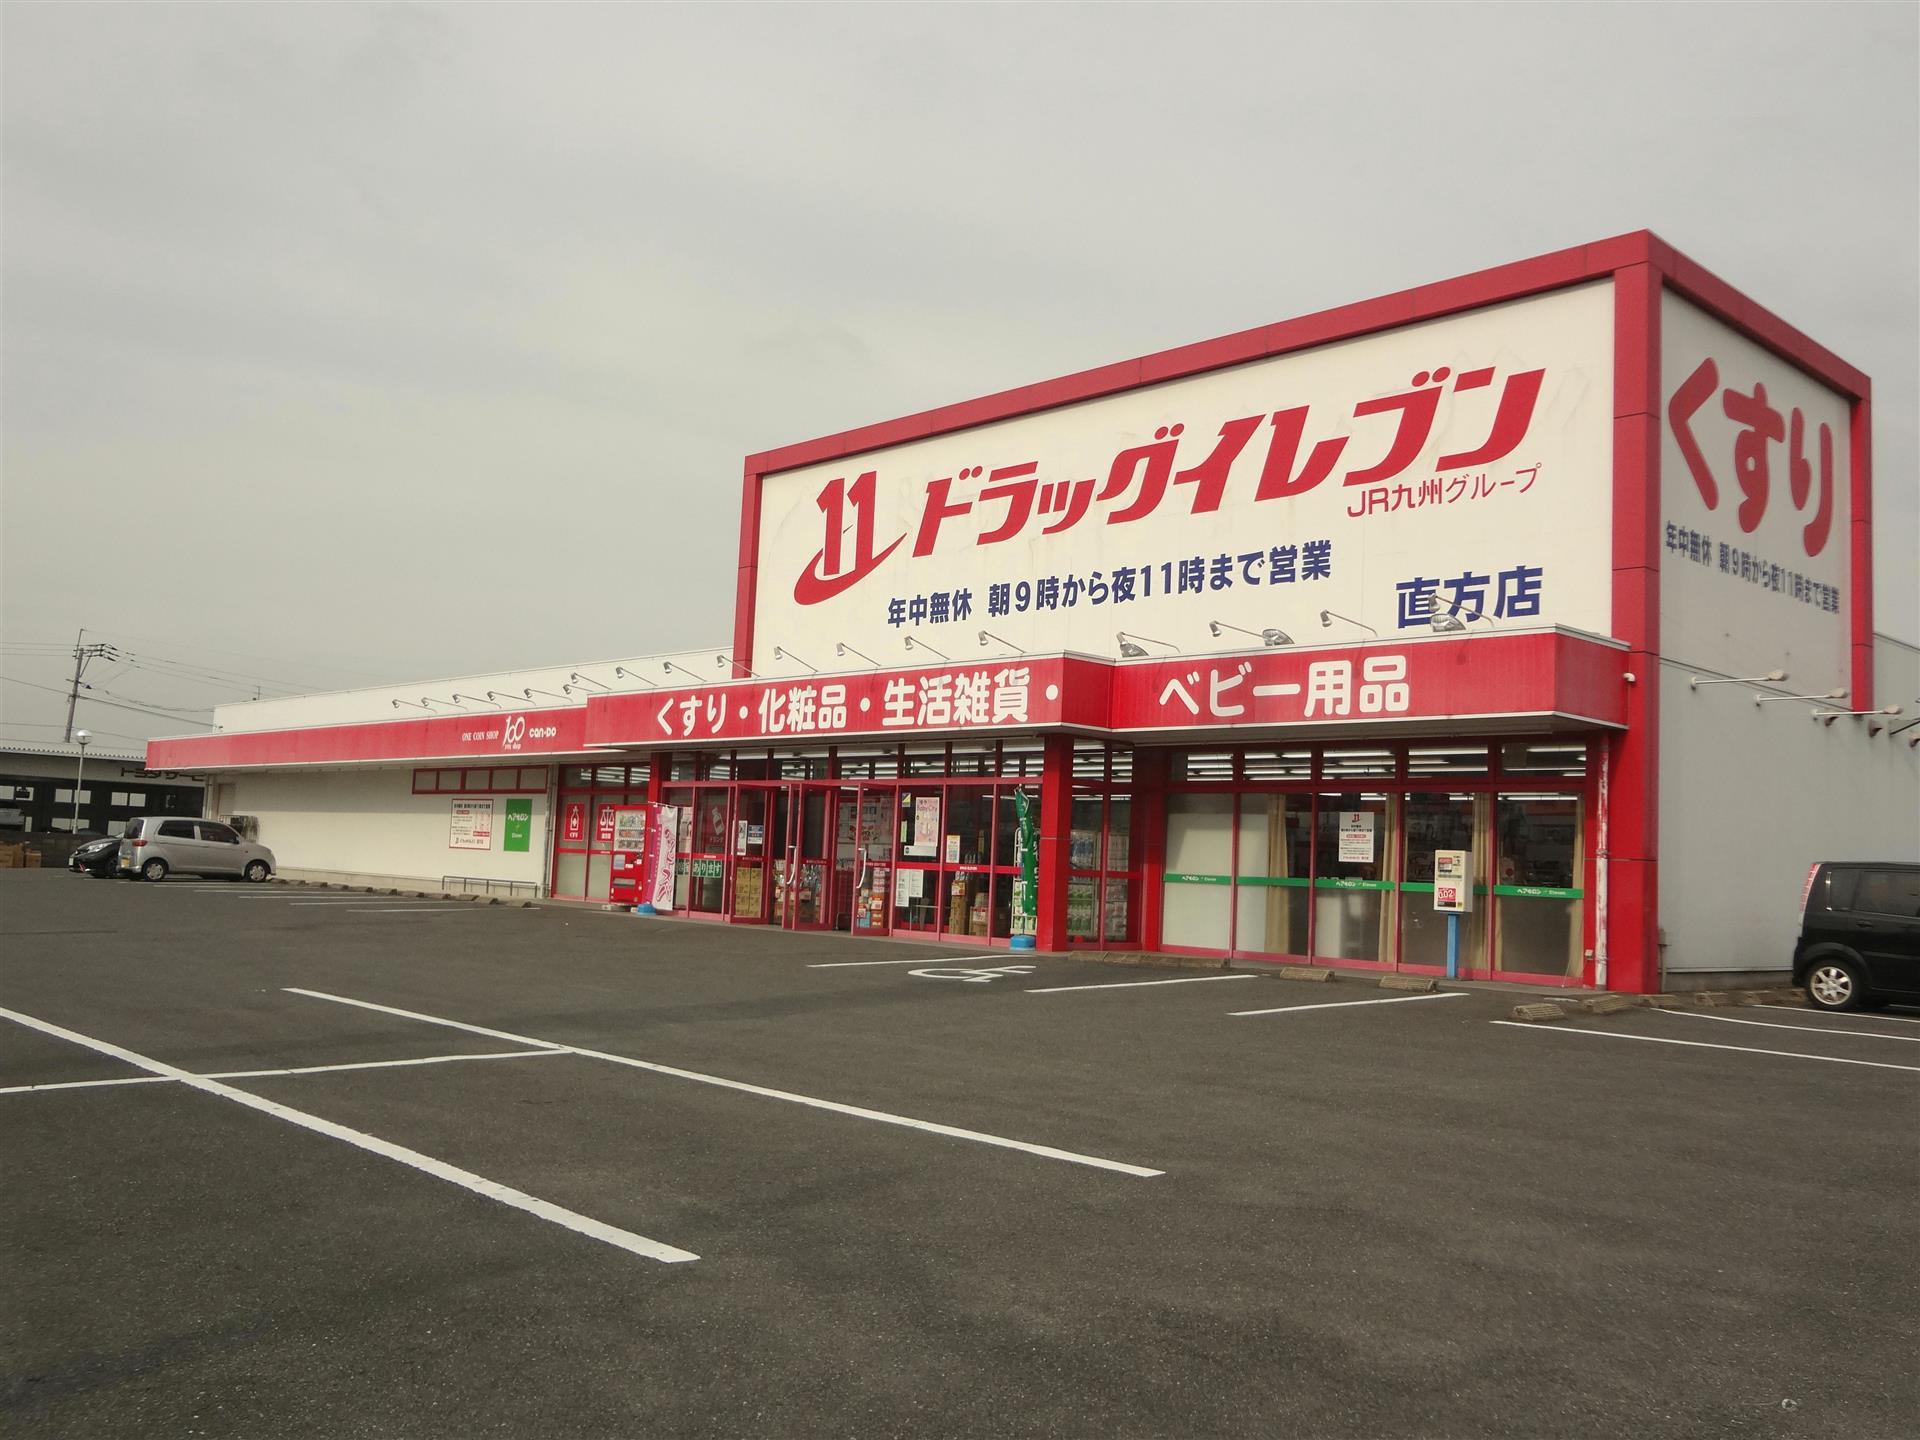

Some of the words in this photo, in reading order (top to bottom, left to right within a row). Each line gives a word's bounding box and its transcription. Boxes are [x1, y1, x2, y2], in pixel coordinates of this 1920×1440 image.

[912, 366, 1546, 557] ドラッグイレブン
[1347, 462, 1542, 517] JR九州グループ
[1668, 357, 1833, 557] くすり
[888, 588, 973, 628] 年中無休
[988, 540, 1332, 617] 朝9時から夜11時まで営業
[1396, 565, 1543, 628] 直方店
[1666, 520, 1713, 568] 年中無休
[1719, 541, 1840, 615] 朝9時から夜11時まで営業
[1159, 655, 1409, 717] ベビー用品
